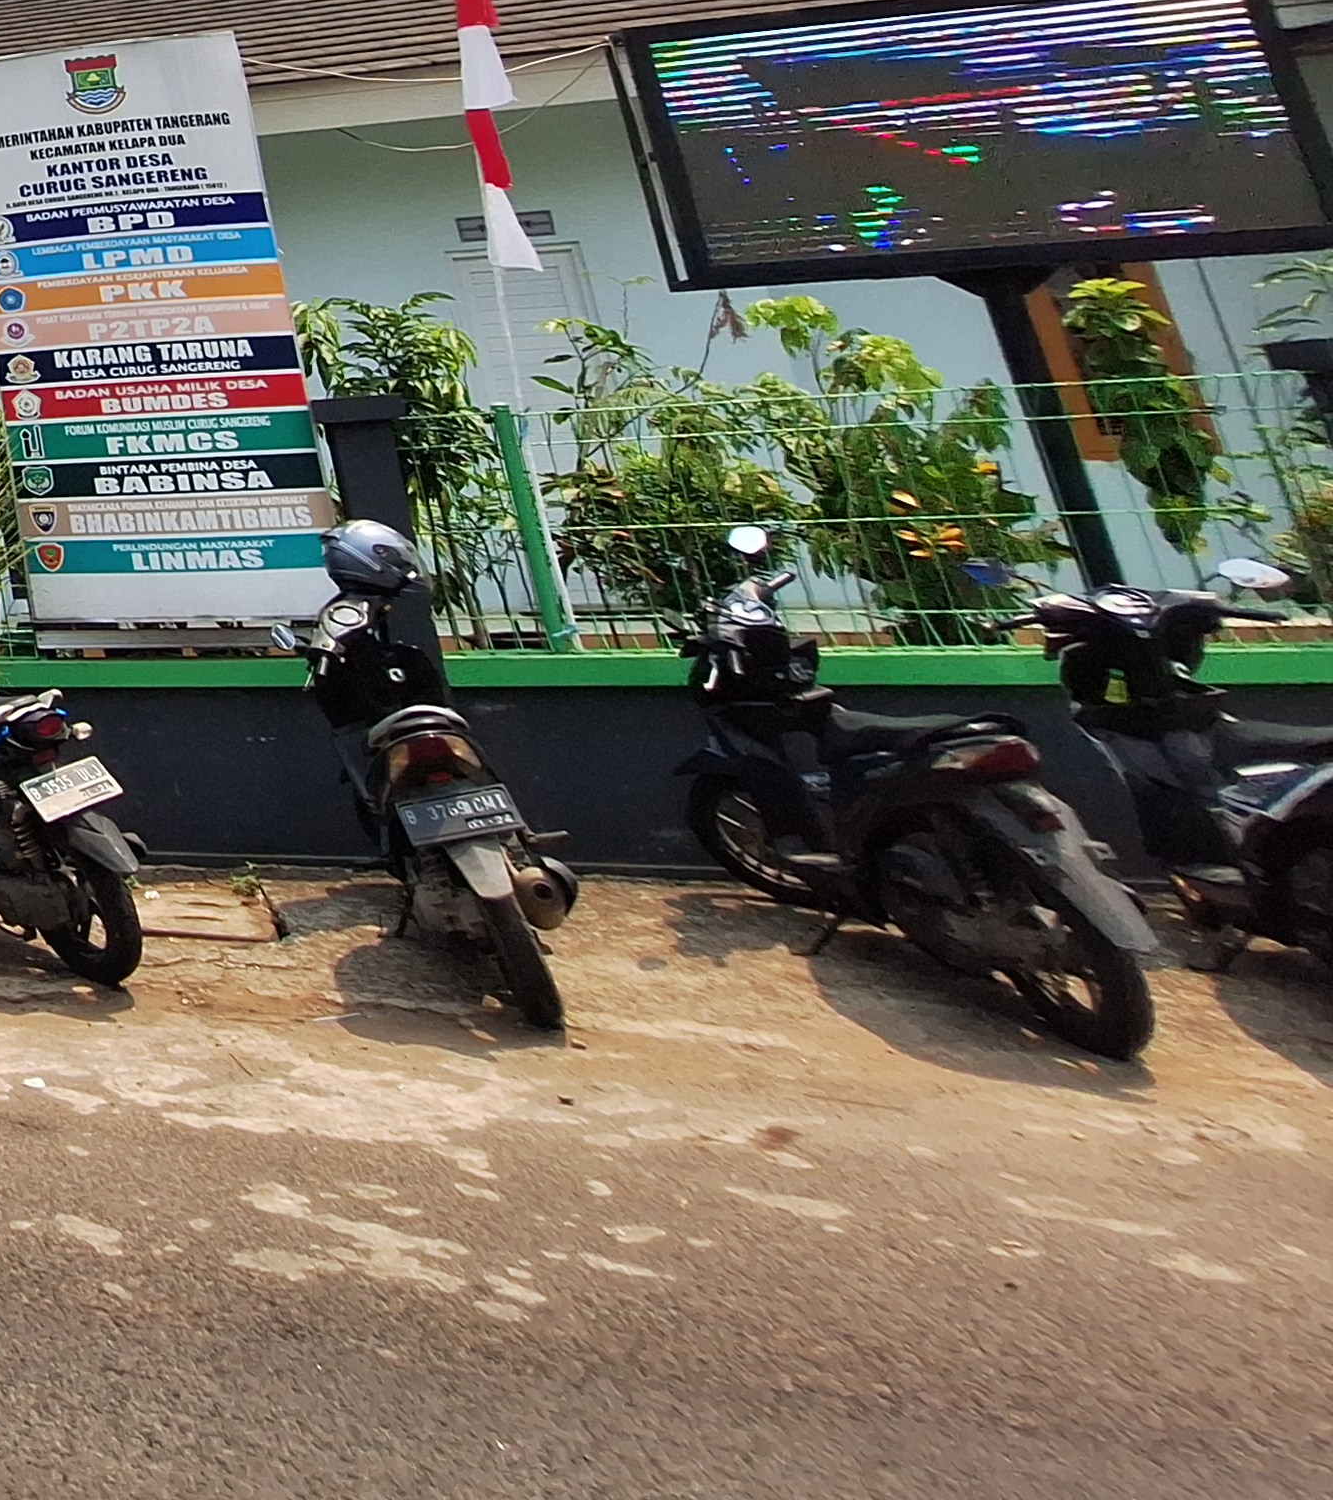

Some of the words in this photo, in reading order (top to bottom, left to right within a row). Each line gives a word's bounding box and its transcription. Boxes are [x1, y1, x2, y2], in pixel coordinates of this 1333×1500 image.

[76, 118, 153, 137] KABUPATEN
[155, 112, 231, 129] TANGERANG
[30, 141, 106, 160] KECAMATAN
[108, 137, 156, 151] KELAPA
[158, 134, 186, 146] DUA
[46, 157, 121, 177] KANTOR
[125, 153, 174, 169] DESA
[19, 178, 86, 197] CURUG
[91, 167, 208, 189] SANGERENG
[26, 209, 69, 223] BADAN
[71, 198, 200, 218] PERMUSYAWARATAN
[202, 196, 236, 208] DESA
[86, 211, 176, 234] BPD
[32, 243, 75, 255] LEMBAGA
[76, 235, 151, 251] PEMBERDAYAAN
[152, 232, 215, 245] MASYARAKAT
[217, 231, 242, 240] DESA
[82, 245, 194, 270] LPMD
[37, 273, 114, 289] PEMBERDAYAAN
[197, 265, 249, 277] KELUARGA
[99, 279, 188, 302] PKK
[88, 315, 215, 340] P2TP2A
[53, 345, 152, 368] KARANG
[156, 339, 254, 361] TARUNA
[71, 366, 107, 379] DESA
[109, 364, 157, 377] CURUG
[160, 360, 241, 374] SANGERENG
[54, 387, 110, 400] BADAN
[115, 383, 172, 396] USAHA
[176, 381, 221, 393] MILIK
[226, 378, 268, 390] DESA
[100, 392, 229, 414] BUMDES
[64, 424, 95, 436] FORUM
[96, 421, 151, 434] KOMUNIKASI
[152, 419, 186, 431] MUSLIM
[187, 417, 218, 429] CURUG
[219, 416, 271, 428] SANGERENG
[105, 430, 239, 455] FKMCS
[99, 463, 158, 476] BINTARA
[160, 461, 220, 473] PEMBINA
[222, 459, 258, 470] DESA
[93, 471, 274, 494] BABINSA
[69, 506, 313, 534] BHABINKAMTIBMAS
[112, 542, 198, 552] PERLINDUNGAN
[200, 539, 275, 550] MASYARAKAT
[131, 549, 265, 571] LINMAS
[29, 786, 43, 801] B
[41, 774, 74, 796] 3535
[75, 762, 103, 782] ULJ
[404, 810, 417, 825] B
[426, 800, 469, 821] 3769
